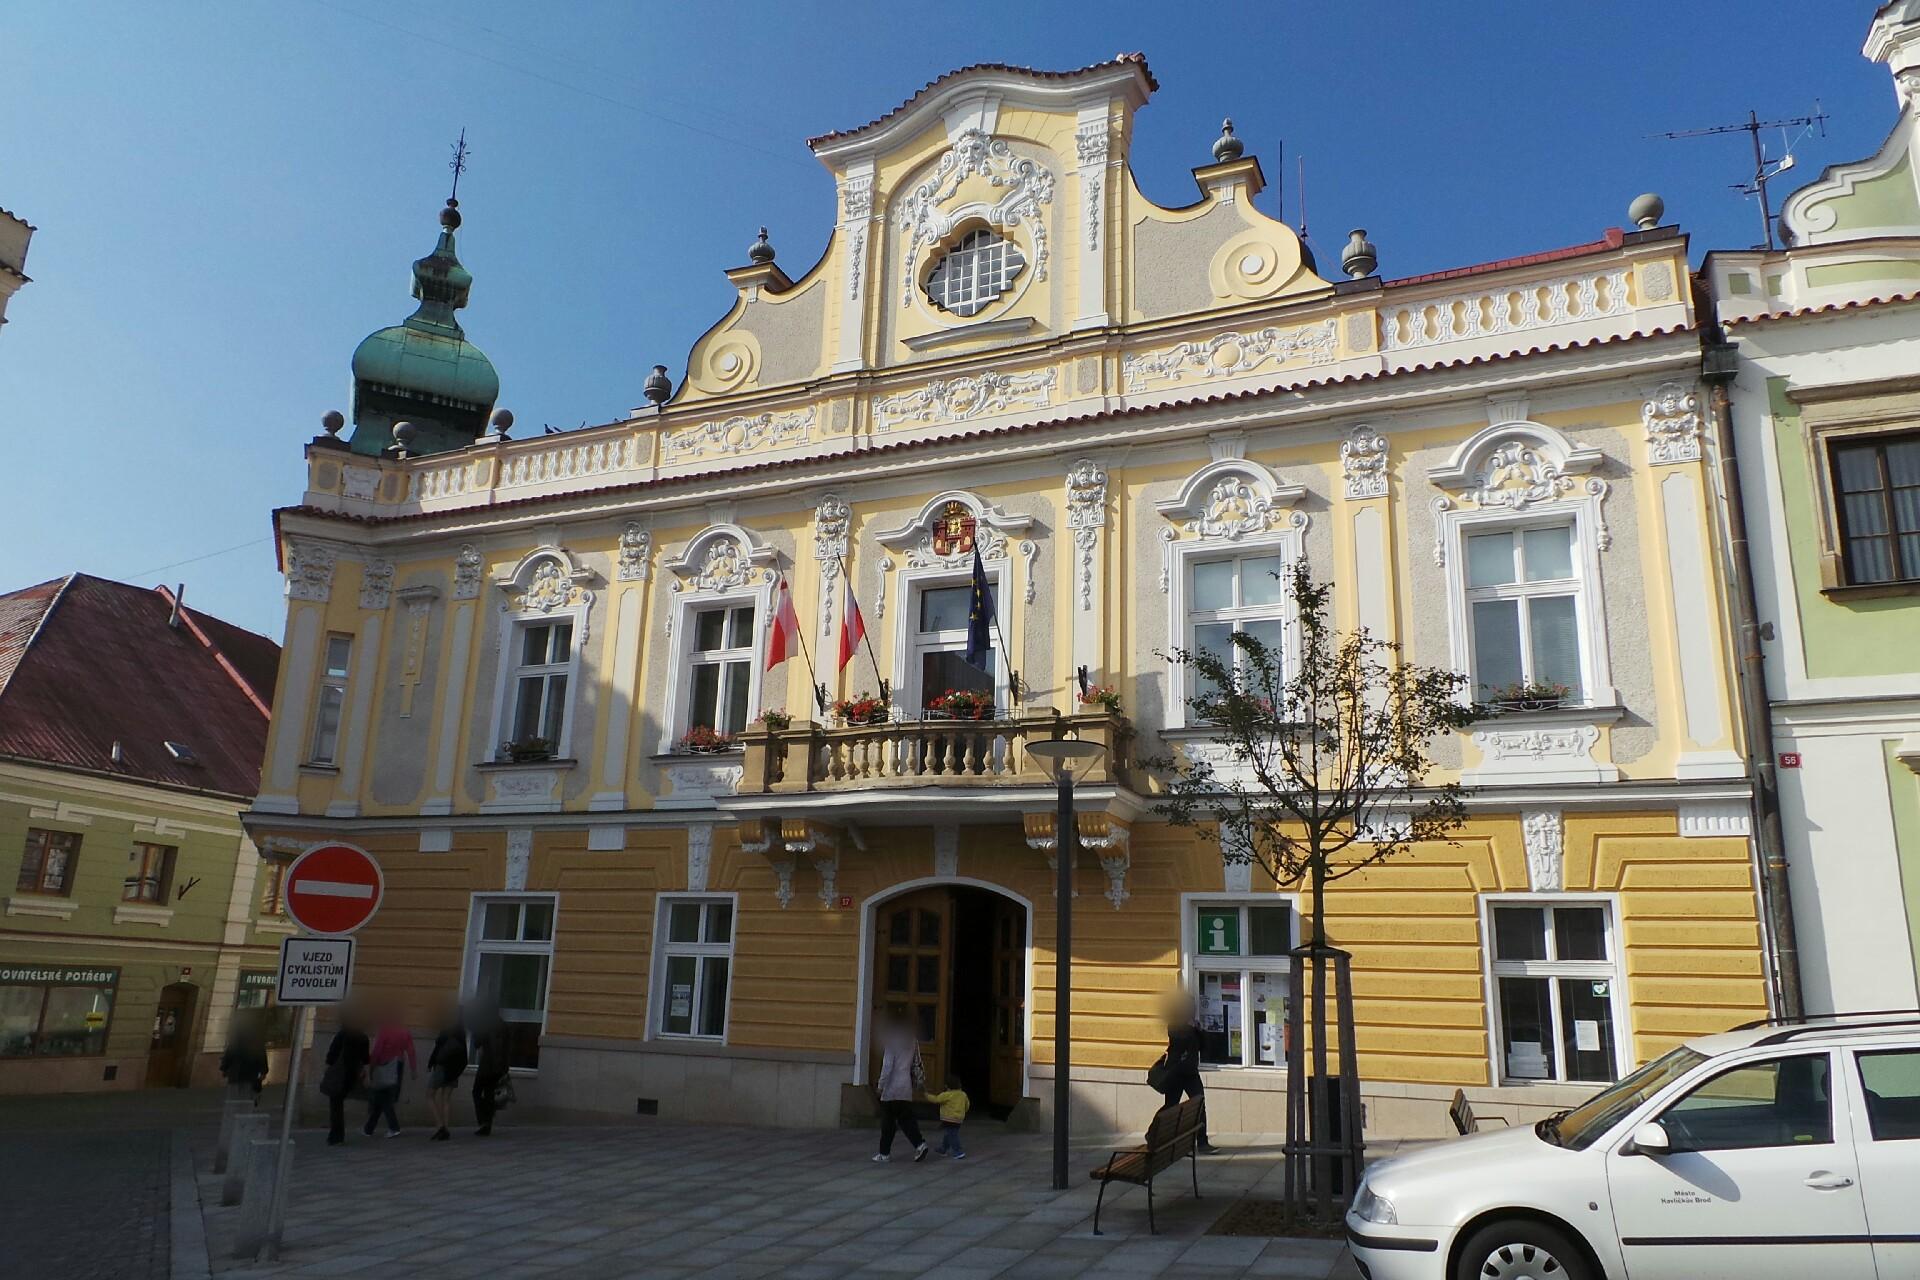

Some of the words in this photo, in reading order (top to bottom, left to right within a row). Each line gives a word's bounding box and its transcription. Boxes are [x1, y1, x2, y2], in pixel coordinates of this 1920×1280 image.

[1785, 756, 1796, 765] 56
[303, 952, 332, 962] VJEZD
[287, 963, 344, 975] CYKLISTŮM
[0, 969, 61, 981] OVATELSKÉ
[65, 969, 113, 982] POTŘEBY
[291, 978, 337, 988] POVOLEN
